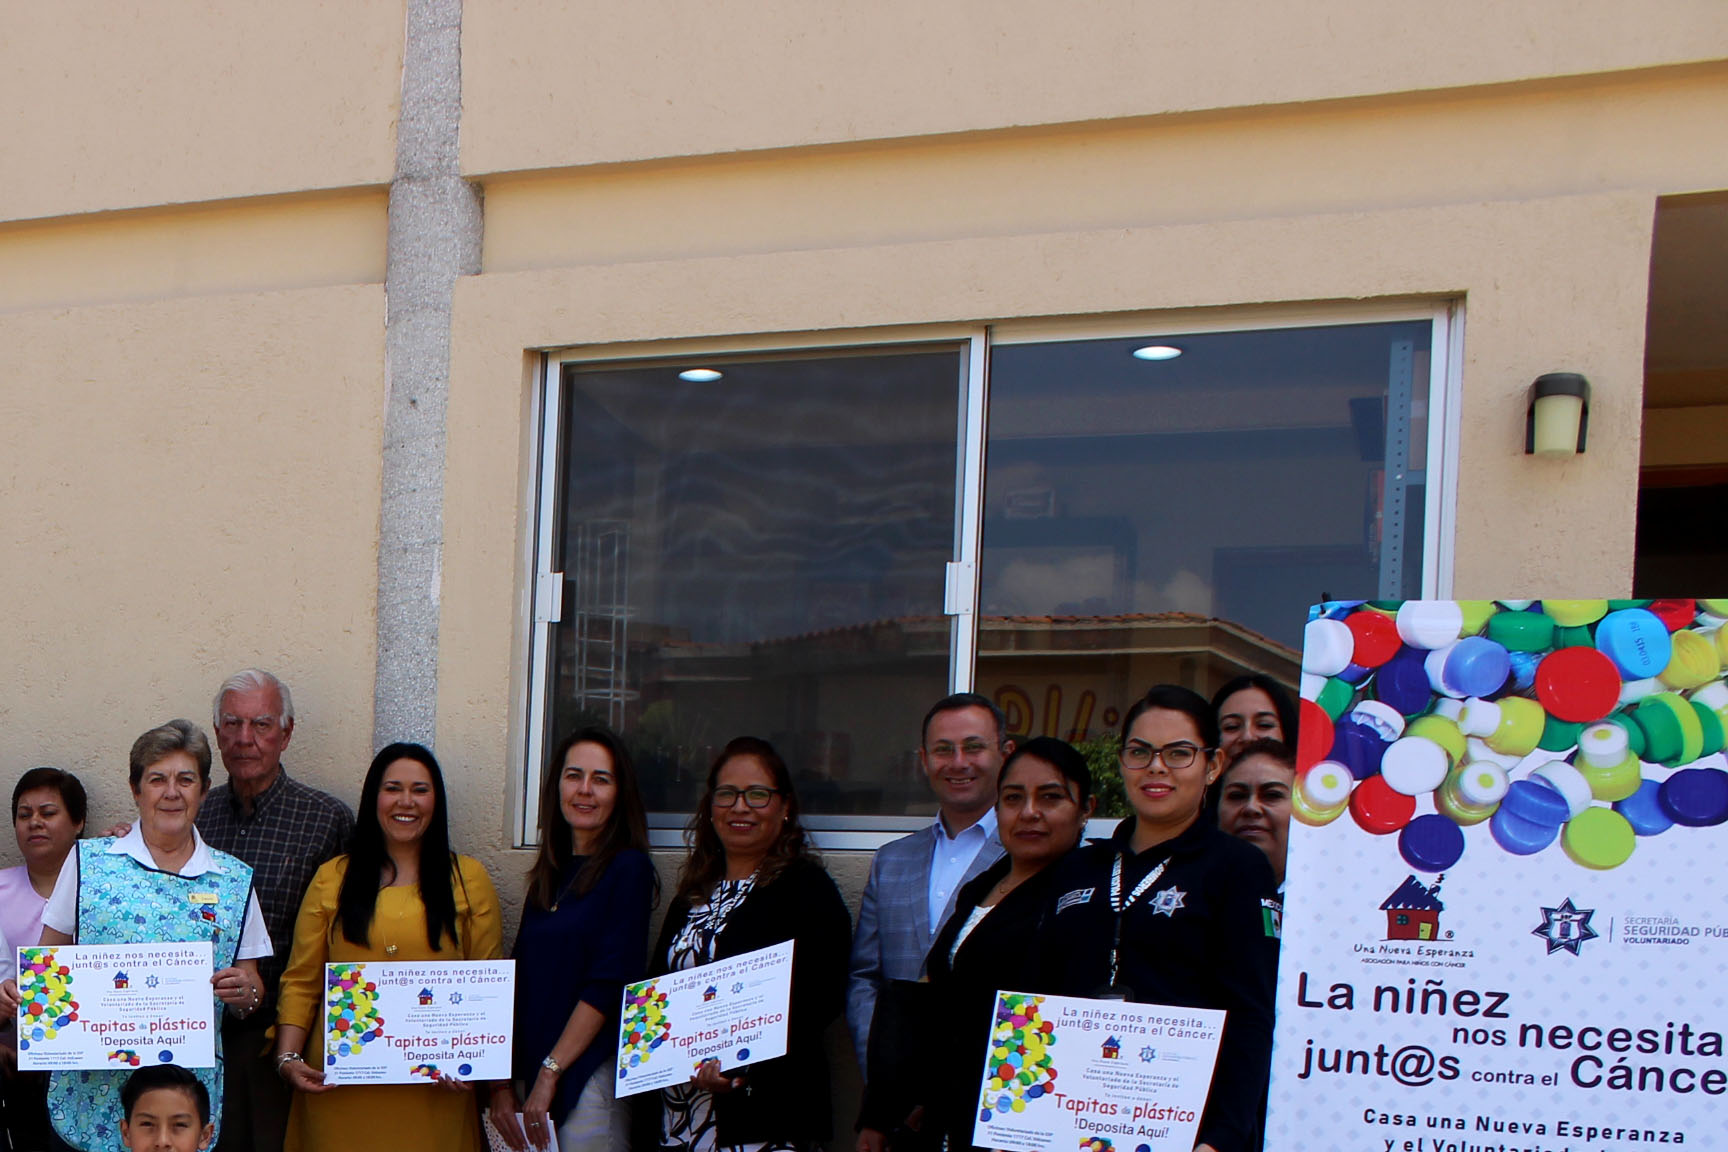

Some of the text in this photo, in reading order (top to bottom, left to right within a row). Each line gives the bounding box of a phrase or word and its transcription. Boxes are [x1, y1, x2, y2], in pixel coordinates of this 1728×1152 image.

[1624, 916, 1679, 925] SECRETARÍA
[1624, 926, 1699, 936] SEGURIDAD
[92, 952, 121, 960] niñez
[148, 950, 206, 960] necesita...
[1354, 944, 1375, 953] Una
[1417, 946, 1474, 958] Esperanza
[71, 955, 207, 970] junt@s contra el Cáncer.
[1297, 971, 1510, 1019] La niñez
[79, 1020, 136, 1036] Tapitas
[150, 1016, 207, 1035] plástico
[101, 1035, 186, 1048] !Deposita Aquí!
[1452, 1022, 1723, 1057] nos necesita
[404, 1049, 485, 1062] !Deposita Aquí!
[1297, 1039, 1461, 1087] junt@s
[1471, 1068, 1535, 1085] contra
[1541, 1073, 1558, 1086] el
[1074, 1118, 1170, 1140] !Deposita Aquí!
[1364, 1108, 1685, 1145] Casa una Nueva Esperanza
[1403, 1138, 1423, 1152] el
